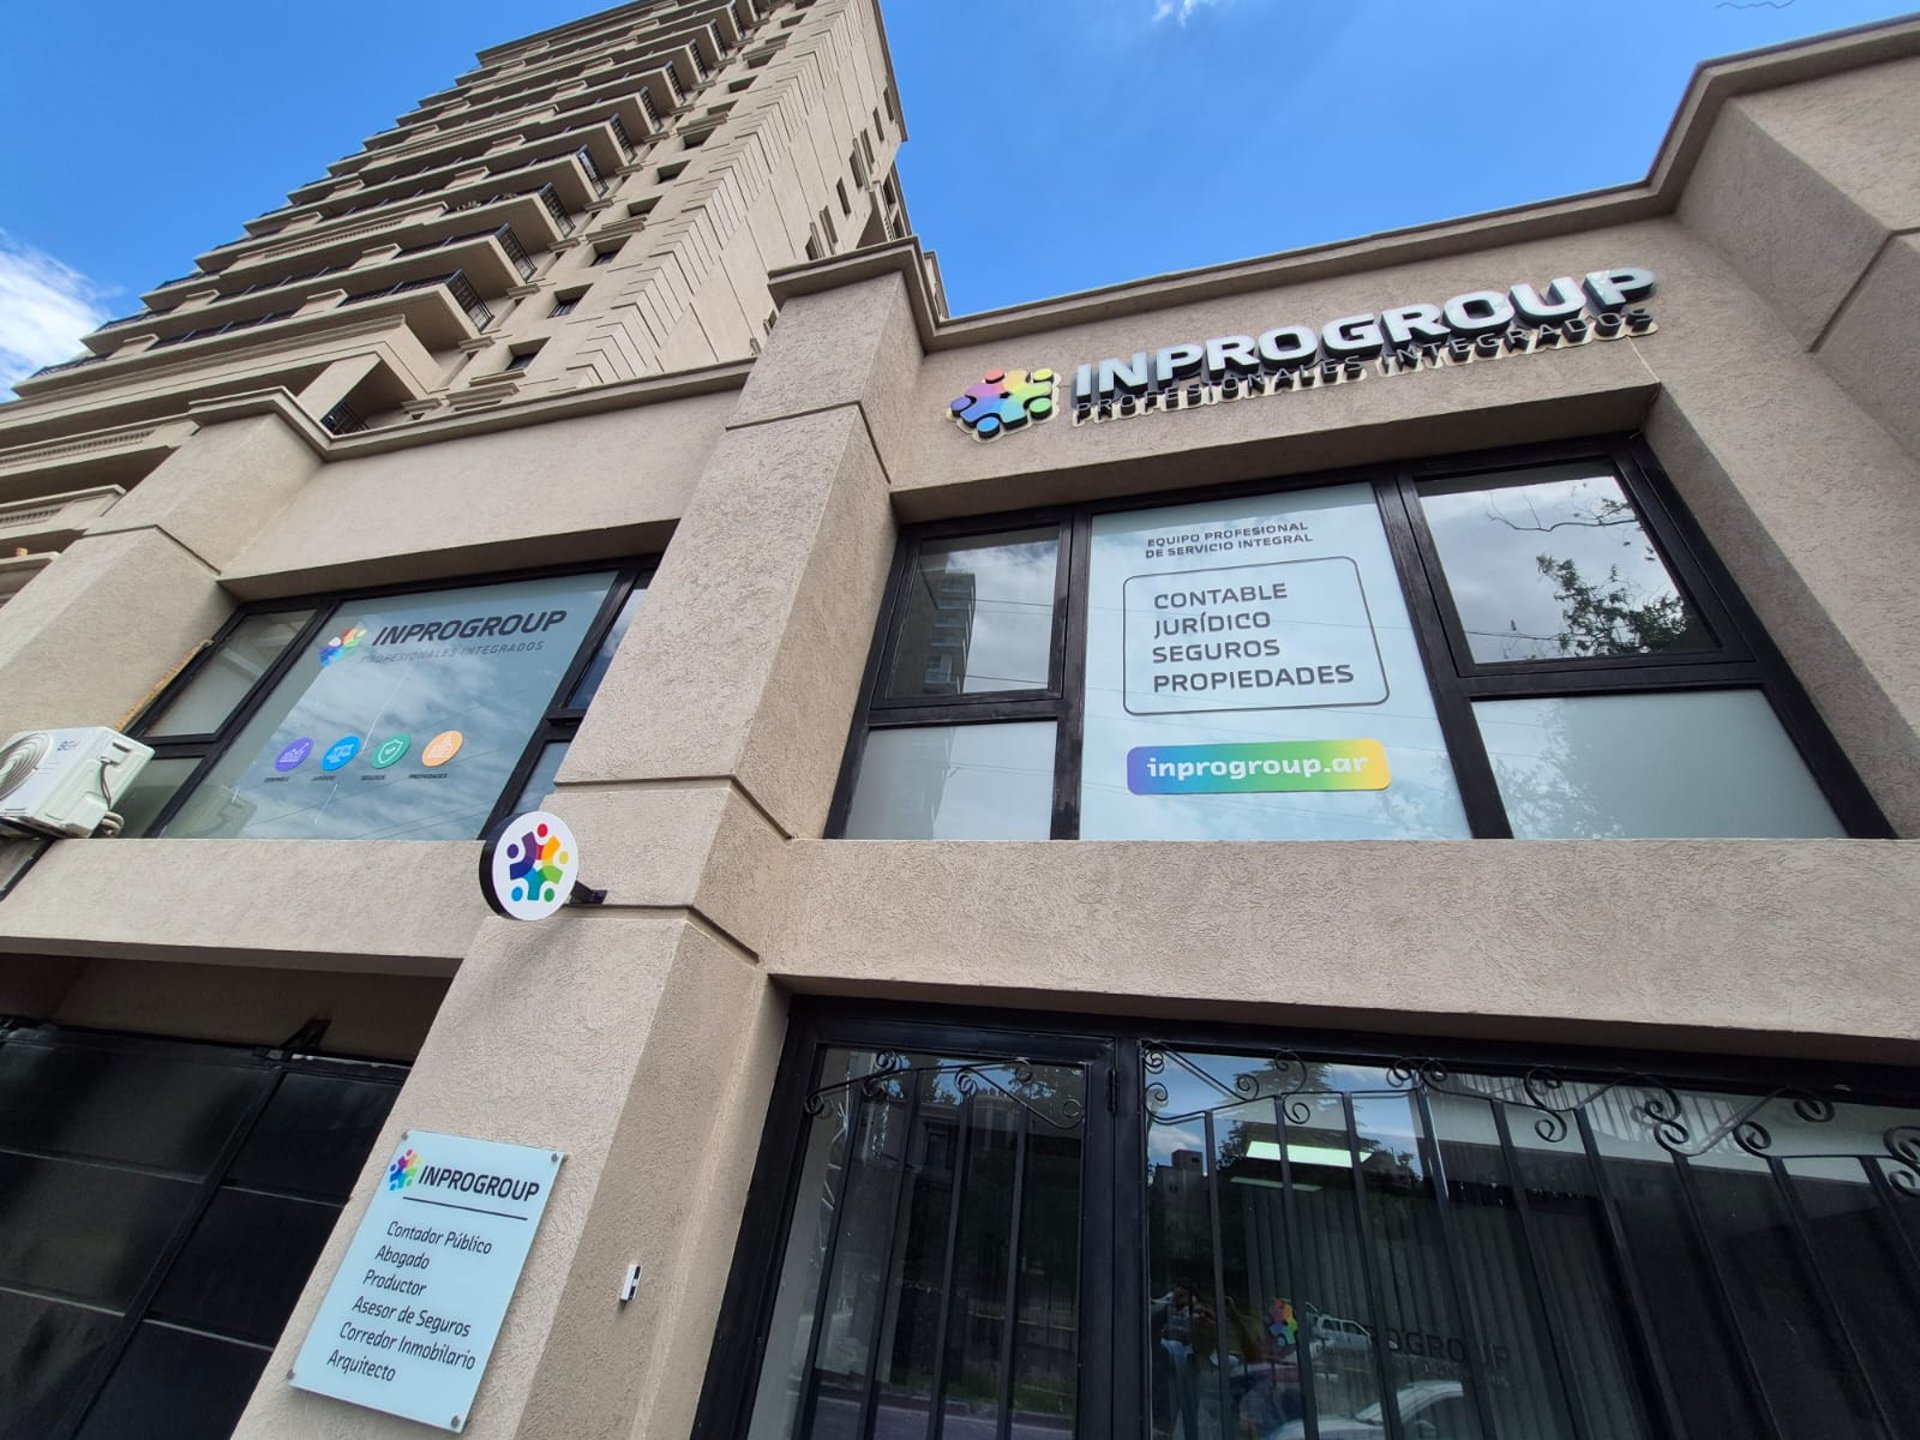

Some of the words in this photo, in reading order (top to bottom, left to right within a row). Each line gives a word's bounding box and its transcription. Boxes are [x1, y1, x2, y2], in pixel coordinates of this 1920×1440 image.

[1073, 267, 1656, 404] INPROGROUP
[1075, 355, 1364, 422] PROFESIONALES
[1382, 308, 1655, 374] INTEGRADOS
[1145, 549, 1164, 559] DE
[1168, 541, 1234, 557] SERVICIO
[1238, 533, 1313, 549] INTEGRAL
[1147, 533, 1200, 548] EQUIPO
[1204, 522, 1309, 540] PROFESIONAL
[1153, 582, 1288, 610] CONTABLE
[371, 610, 568, 647] INPROGROUP
[1153, 611, 1271, 639] JURÍDICO
[460, 640, 545, 657] INTEGRADOS
[1152, 639, 1281, 664] SEGUROS
[1153, 664, 1355, 693] PROPIEDADES
[1146, 756, 1370, 781] inprogroup.ar
[418, 1165, 541, 1202] INPROGROUP
[386, 1220, 444, 1245] Contador
[444, 1230, 493, 1255] Público
[374, 1244, 431, 1270] Abogado
[362, 1268, 428, 1296] Productor
[352, 1295, 398, 1320] Asesor
[397, 1305, 416, 1325] de
[415, 1309, 472, 1337] Seguros
[339, 1321, 399, 1350] Corredor
[326, 1348, 397, 1383] Arquitecto
